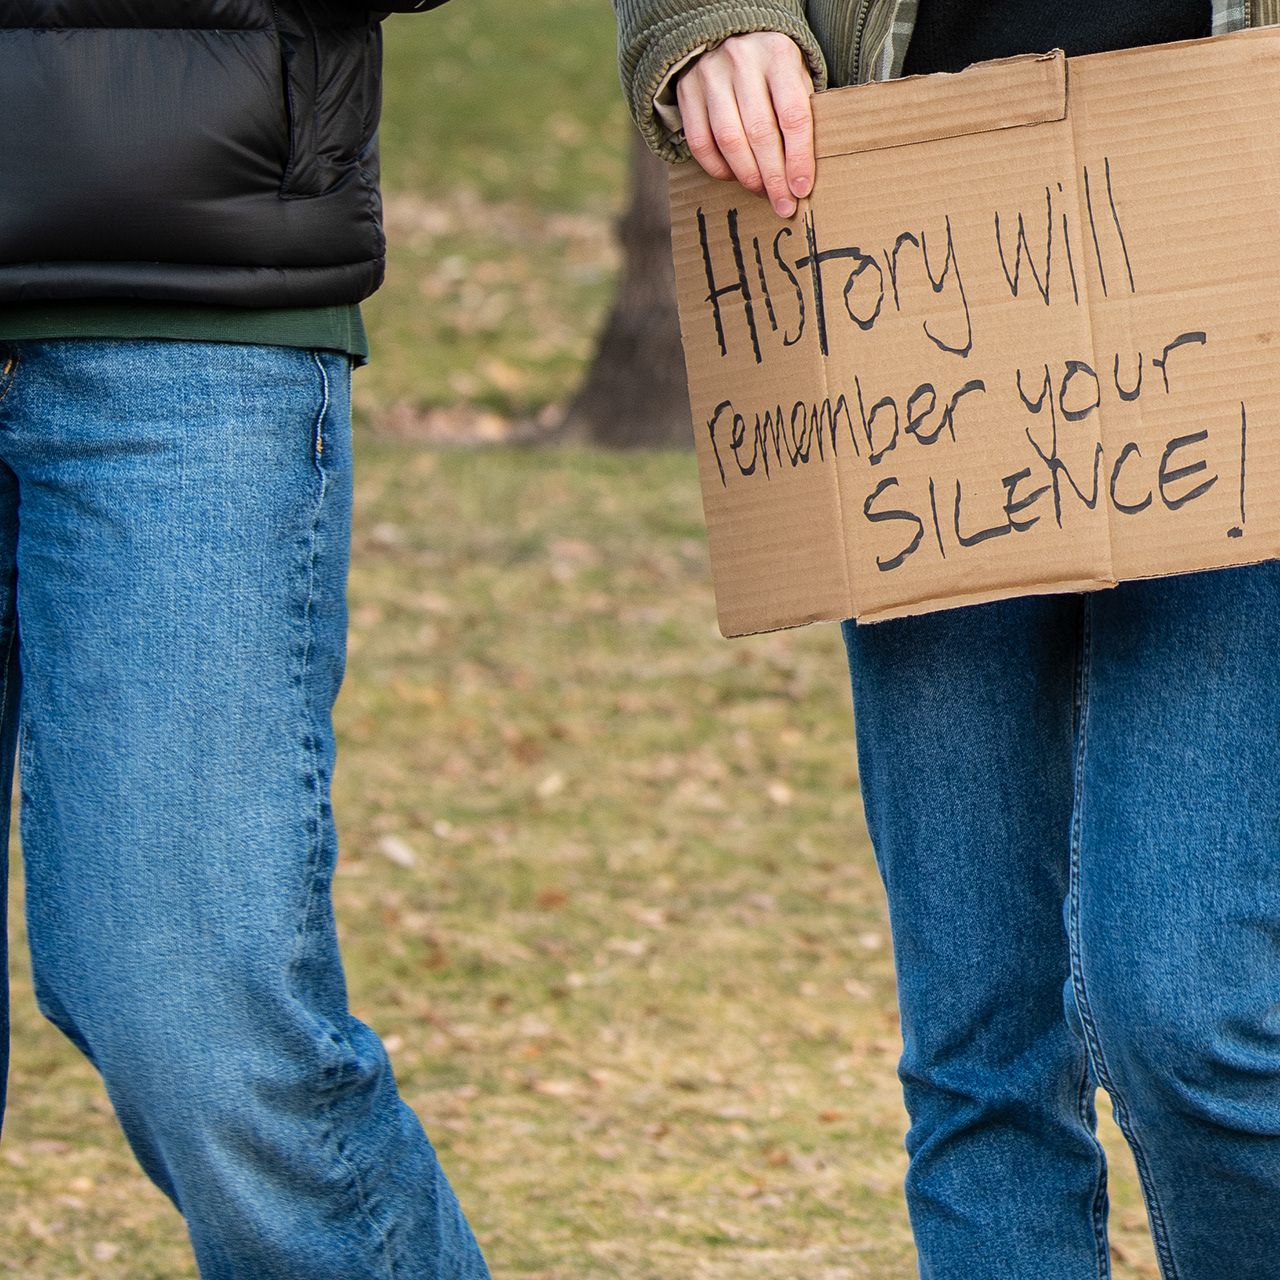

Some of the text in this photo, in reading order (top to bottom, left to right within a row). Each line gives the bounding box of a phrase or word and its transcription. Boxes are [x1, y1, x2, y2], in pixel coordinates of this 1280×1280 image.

[706, 331, 1207, 488] remember your
[862, 401, 1247, 572] SILENCE!
